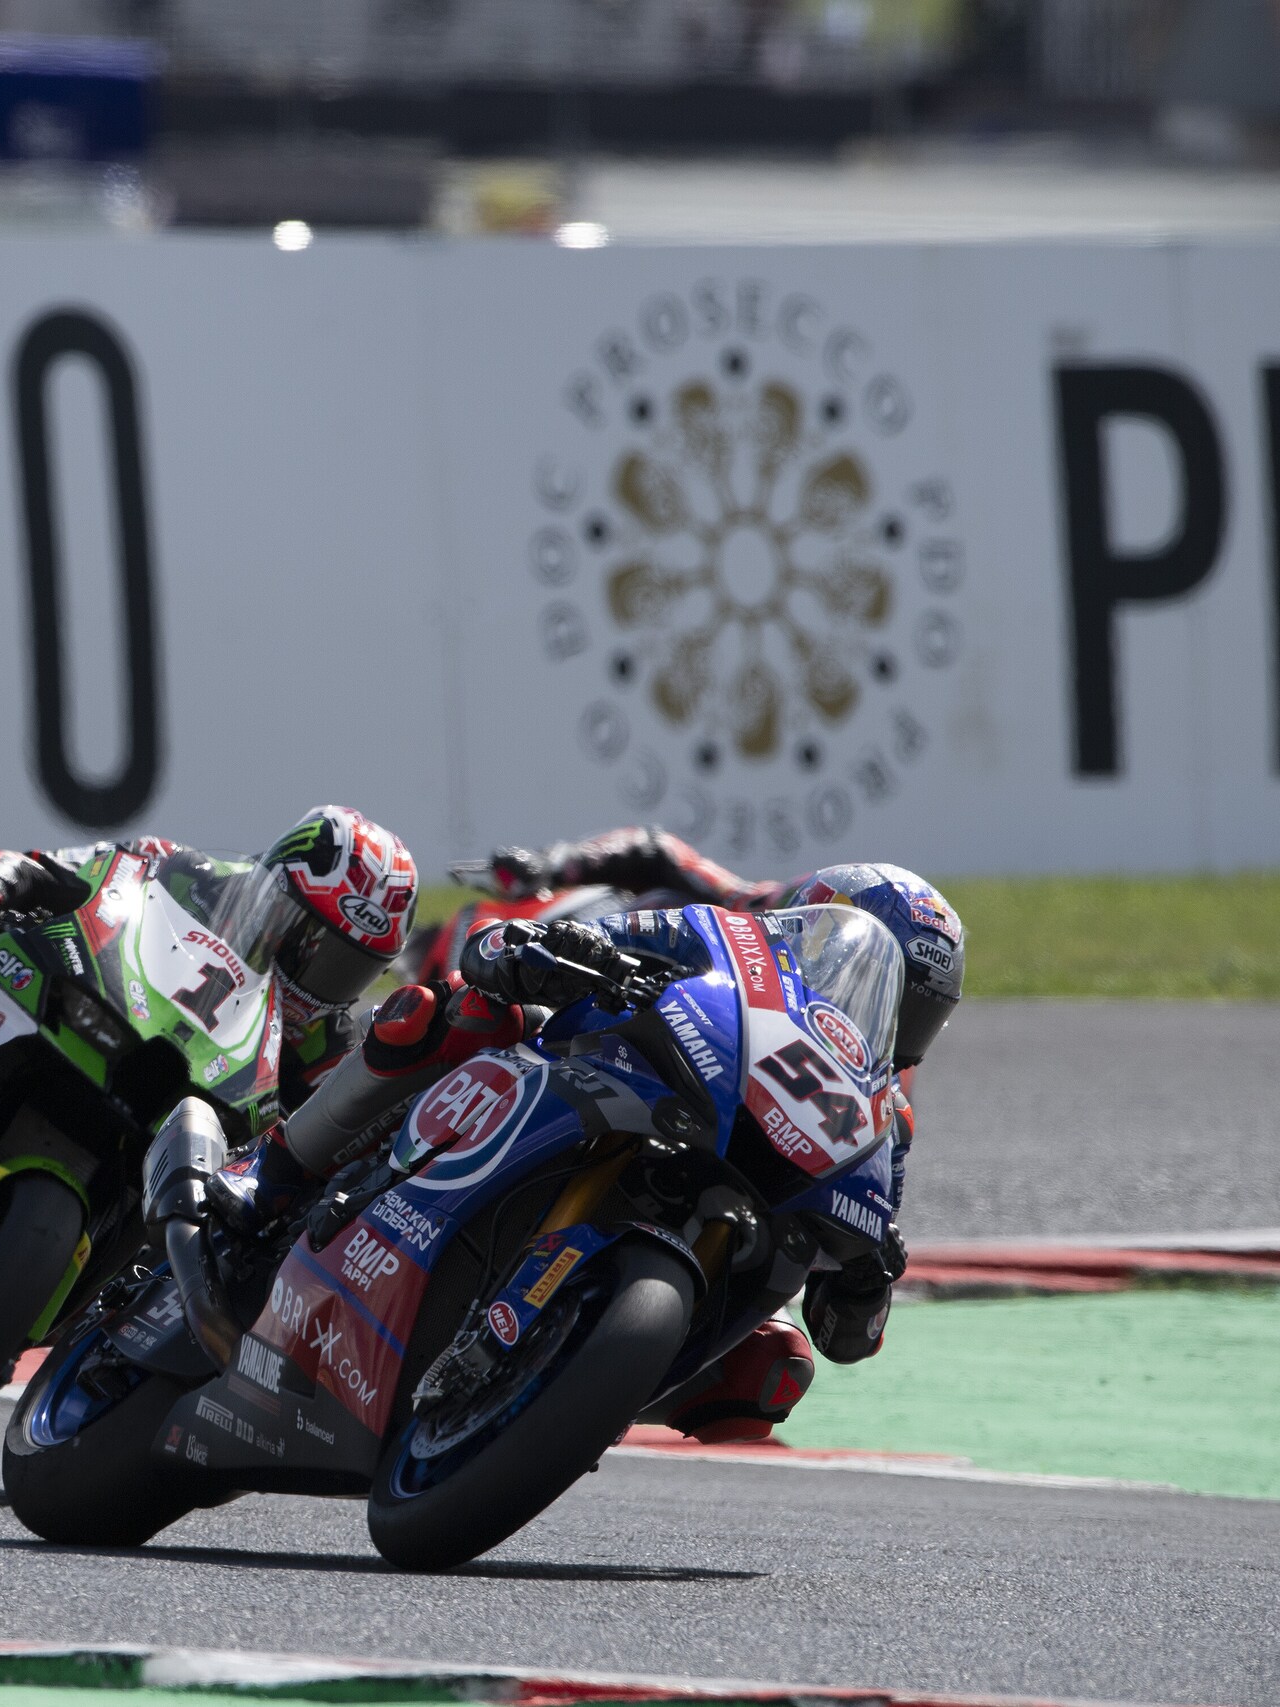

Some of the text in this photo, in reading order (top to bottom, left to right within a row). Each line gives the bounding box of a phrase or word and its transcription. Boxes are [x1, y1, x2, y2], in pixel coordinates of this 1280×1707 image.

[564, 276, 914, 438] PROSECCO
[1052, 358, 1280, 783] P
[343, 902, 387, 931] Arai
[182, 929, 246, 988] SHOWA
[915, 940, 951, 971] SHOEI
[171, 962, 237, 1034] 1
[659, 1000, 724, 1082] YAMAHA
[822, 1015, 864, 1067] PATA
[425, 1071, 504, 1142] PATA
[754, 1038, 868, 1147] 54
[763, 1107, 813, 1155] BMP
[767, 1126, 796, 1157] TAPPI
[830, 1189, 883, 1242] YAMAHA
[341, 1259, 373, 1293] TAPPI
[343, 1228, 400, 1280] BMP
[530, 1251, 578, 1304] PIRELLI
[281, 1285, 378, 1407] BRIXX.COM
[491, 1307, 510, 1338] HEL
[236, 1333, 285, 1395] YAMALUBE
[195, 1394, 234, 1433] PIRELLI
[305, 1417, 336, 1446] balanced
